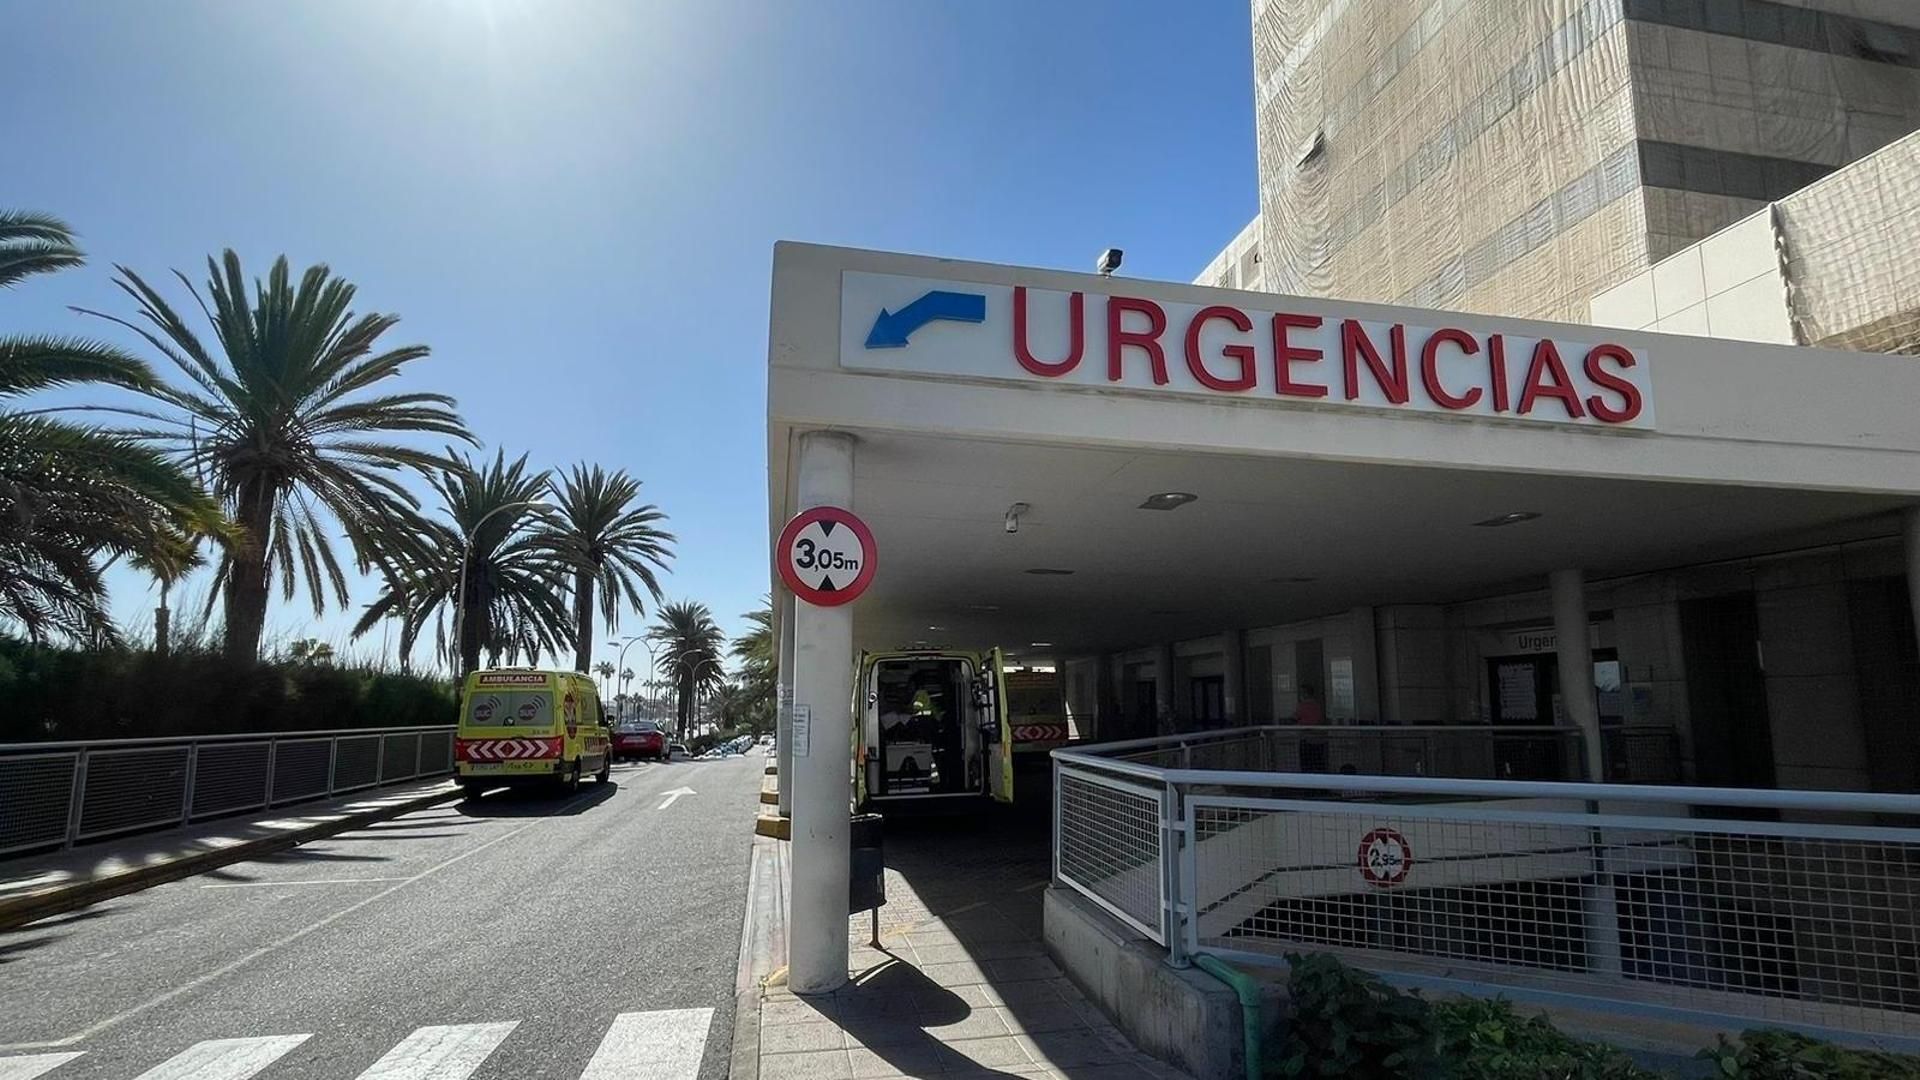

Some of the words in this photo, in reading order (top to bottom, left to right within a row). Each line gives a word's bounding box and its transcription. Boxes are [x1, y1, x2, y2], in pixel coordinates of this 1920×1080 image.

[1014, 286, 1642, 423] URGENCIAS
[796, 538, 859, 573] 3,05m
[482, 675, 543, 683] AMBULANCIA
